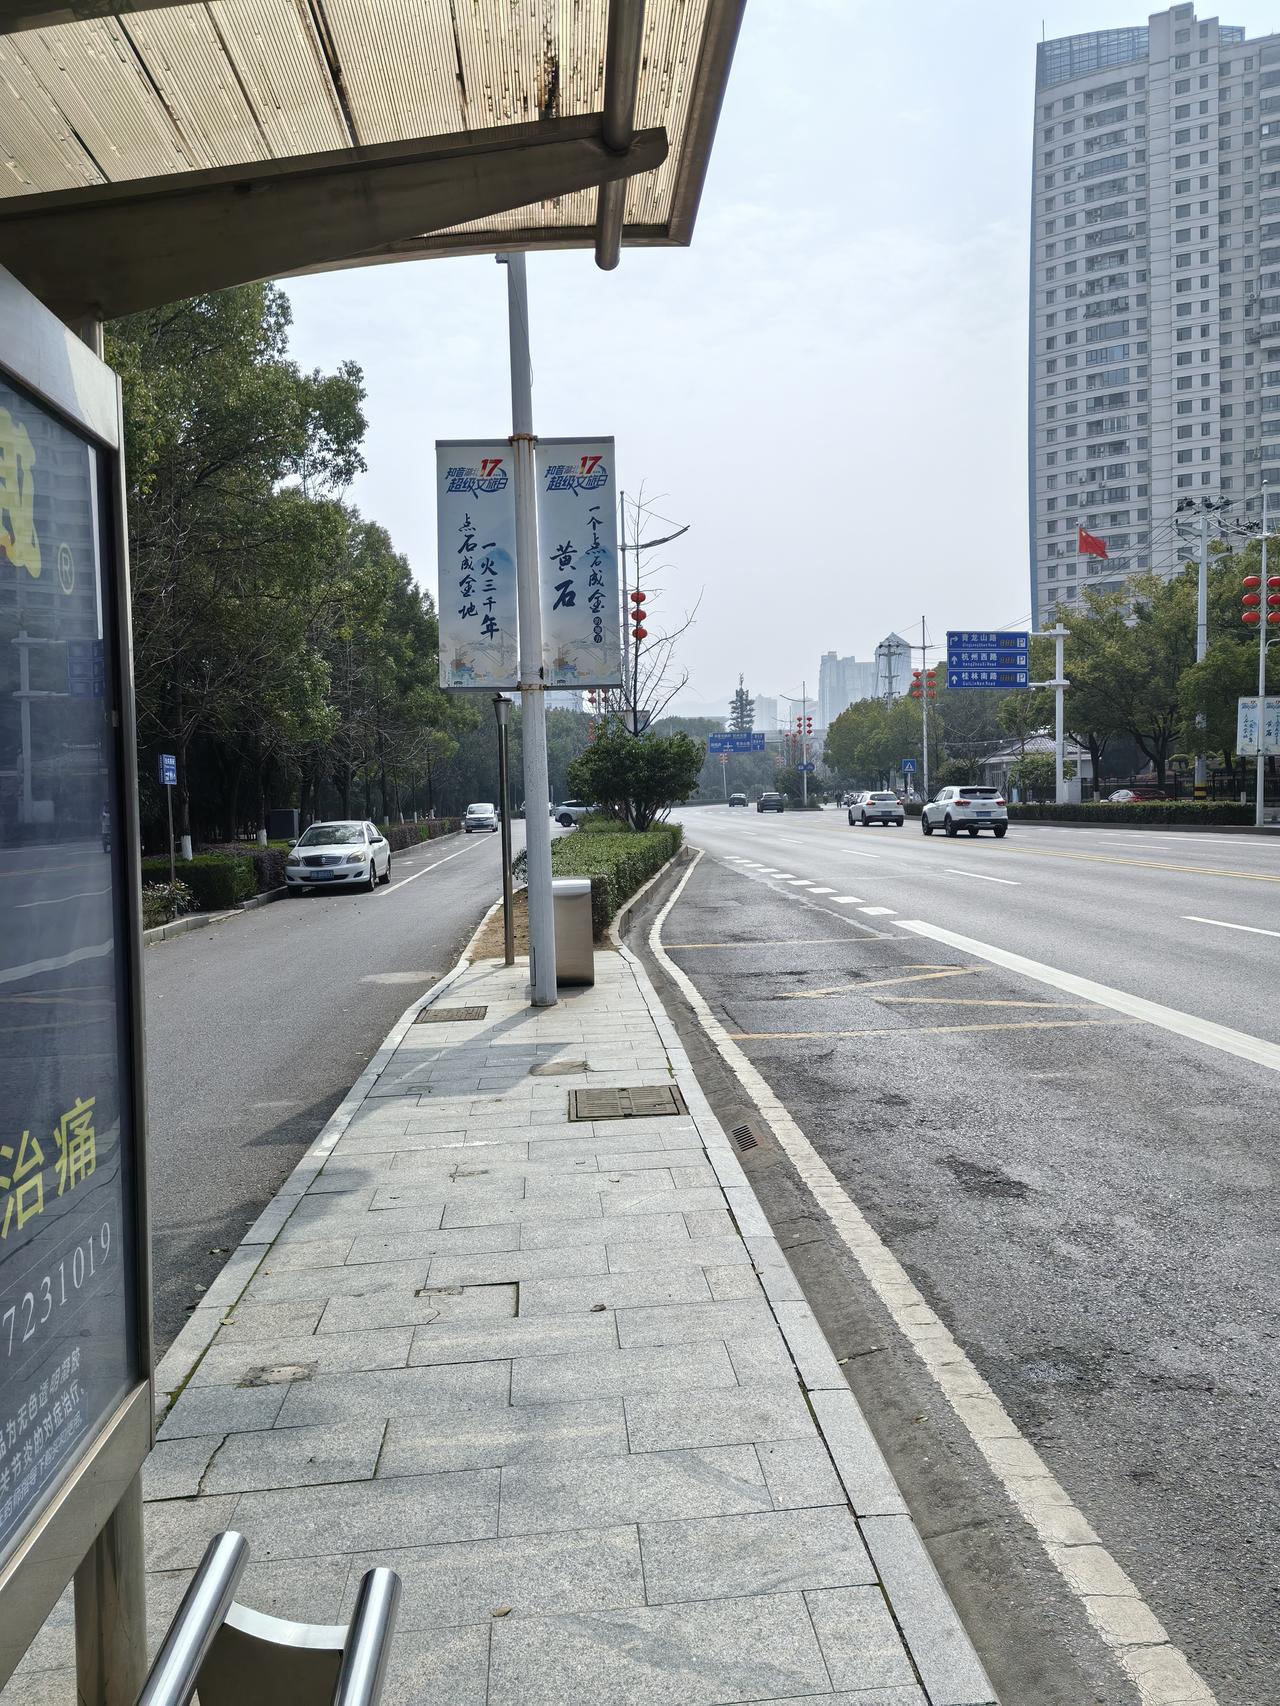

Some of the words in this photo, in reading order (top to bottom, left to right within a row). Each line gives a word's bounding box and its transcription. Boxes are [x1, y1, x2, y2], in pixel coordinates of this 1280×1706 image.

[481, 459, 503, 477] 17
[580, 456, 602, 474] 17
[446, 477, 508, 499] 超级文旅日
[546, 474, 608, 496] 超级文旅日
[457, 513, 479, 619] 点石成金地
[550, 540, 578, 611] 黄石
[480, 542, 500, 640] 一火三千年
[961, 653, 997, 661] 杭州西路
[961, 672, 997, 680] 桂林南路
[0, 1097, 96, 1240] 治痛
[3, 1222, 110, 1357] 7231019
